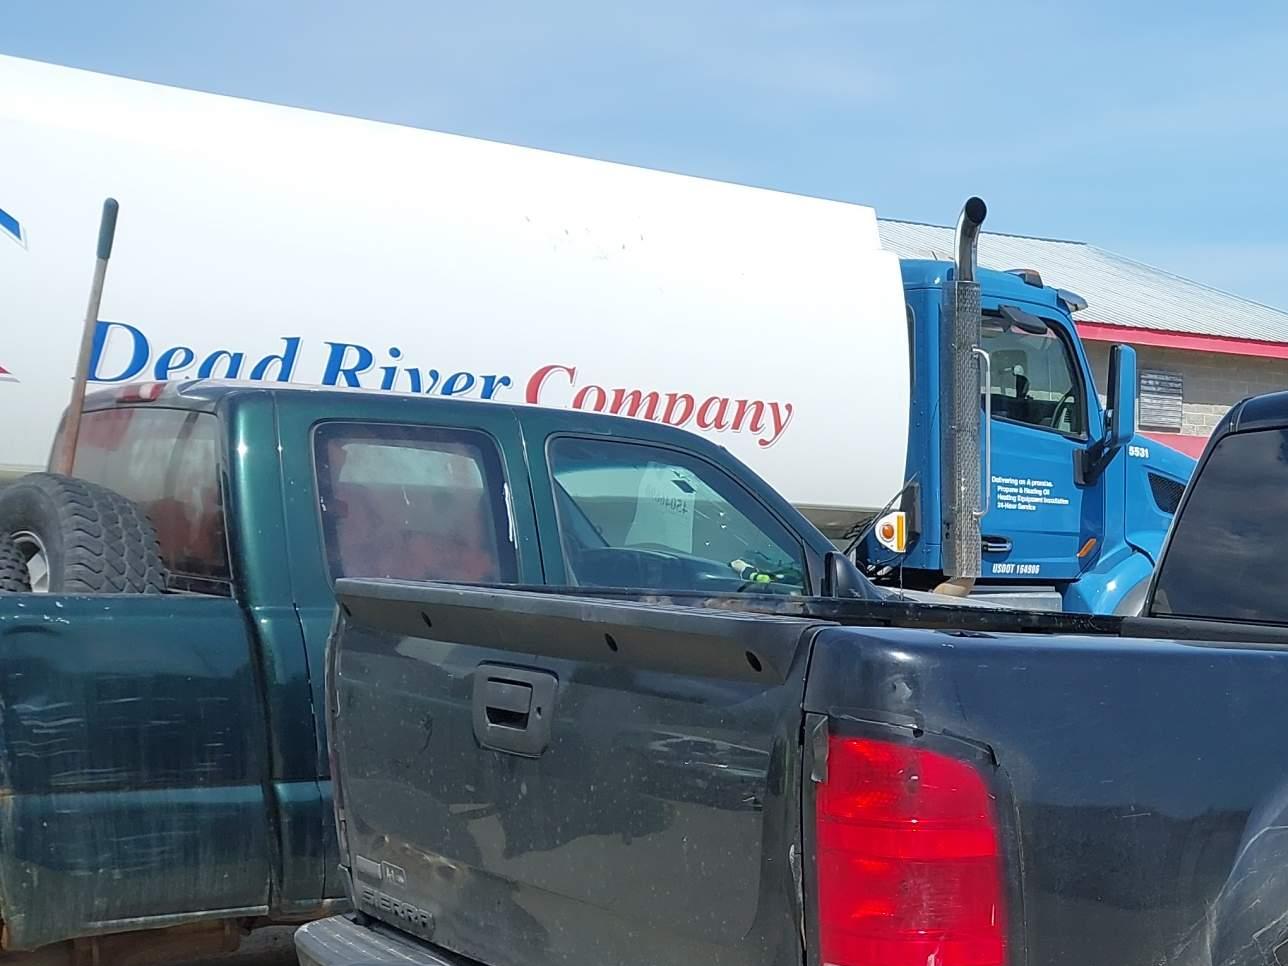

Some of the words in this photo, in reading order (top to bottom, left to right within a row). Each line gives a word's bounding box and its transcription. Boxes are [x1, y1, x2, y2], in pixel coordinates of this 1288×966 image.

[84, 320, 302, 384] Dead
[321, 341, 511, 400] River
[525, 364, 793, 446] Company
[1128, 445, 1149, 458] 5531
[992, 563, 1015, 574] USDOT
[361, 885, 435, 930] SIERRA
